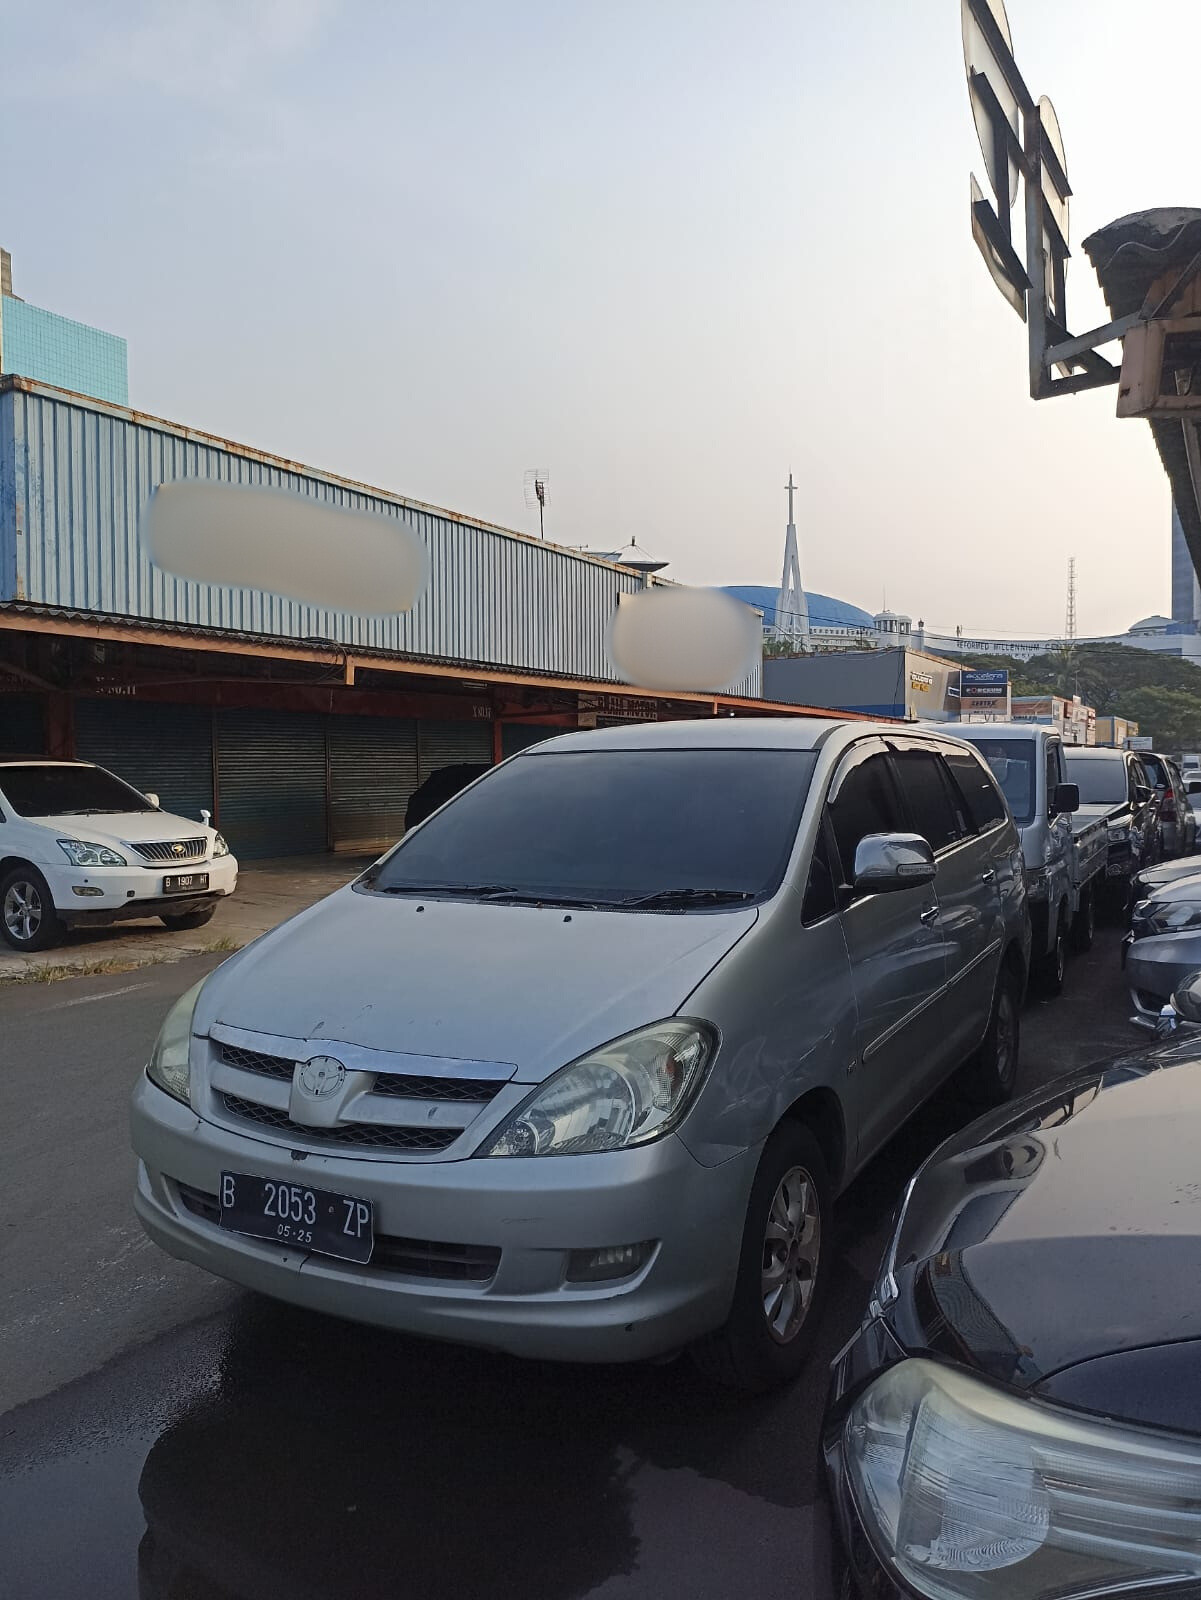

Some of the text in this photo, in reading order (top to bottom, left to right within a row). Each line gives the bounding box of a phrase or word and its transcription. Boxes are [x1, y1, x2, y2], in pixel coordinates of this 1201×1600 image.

[993, 643, 1040, 651] MILLENNIUM
[165, 877, 171, 887] B
[222, 1175, 369, 1238] B 2053 ZP
